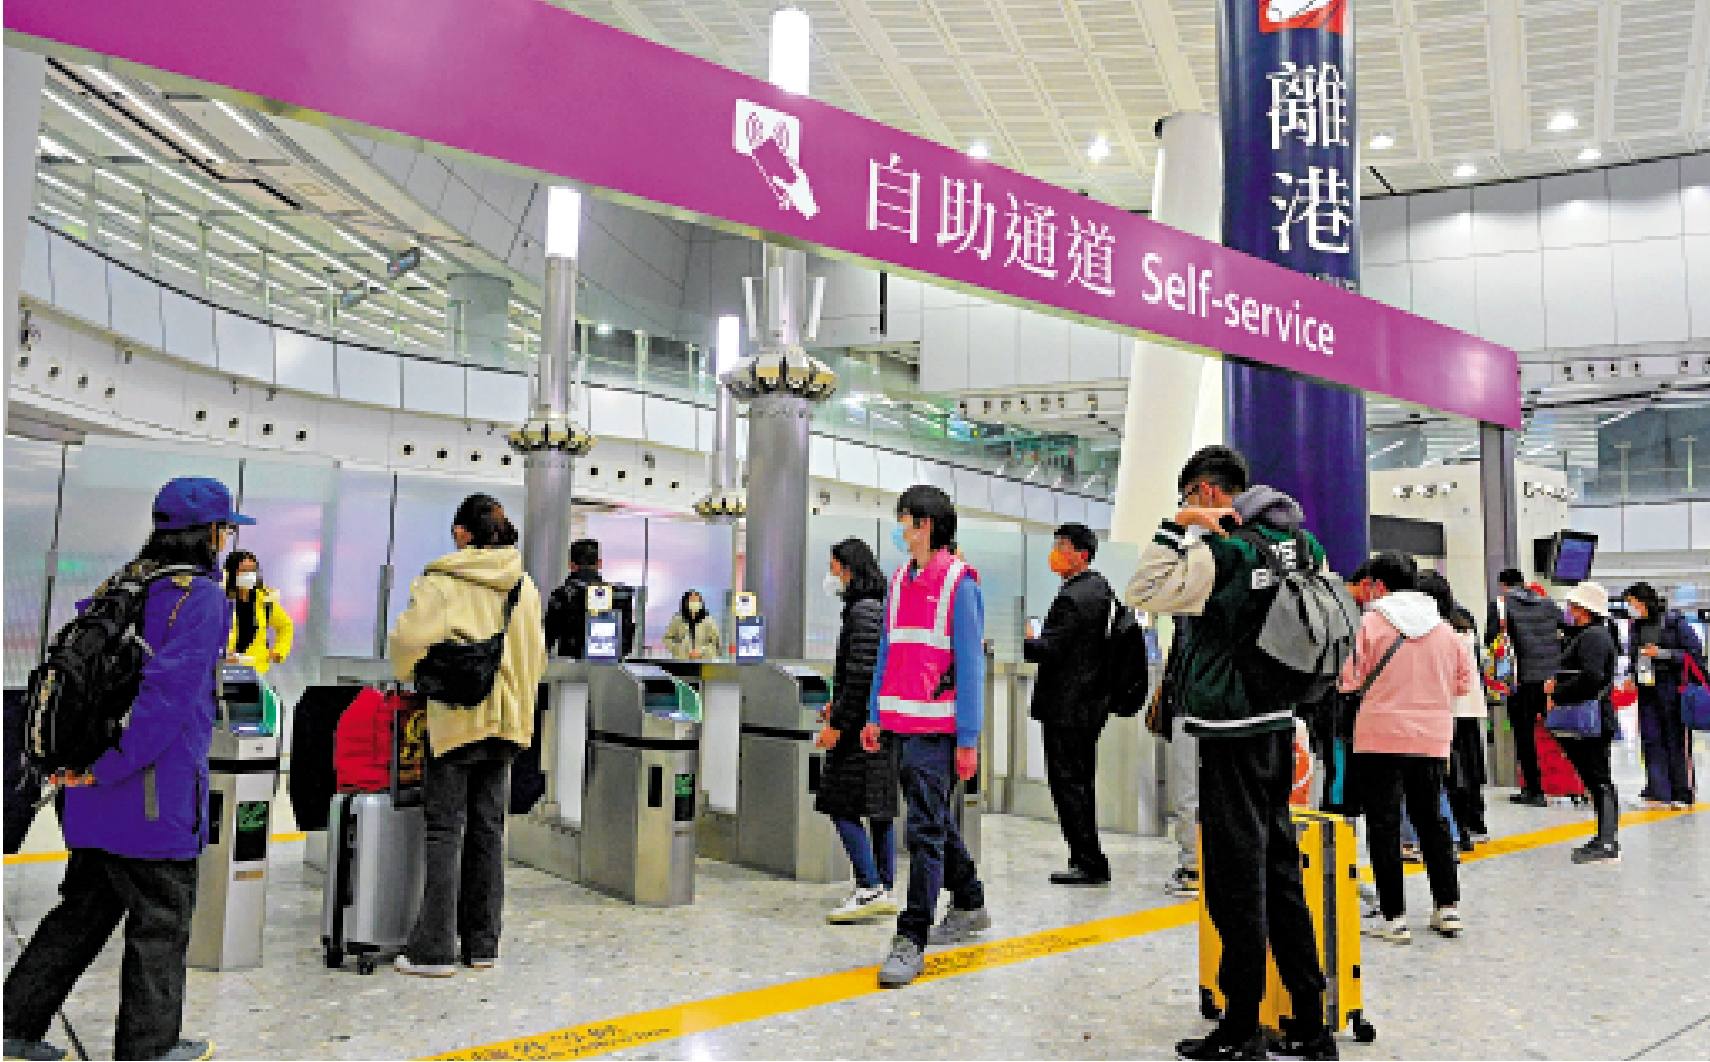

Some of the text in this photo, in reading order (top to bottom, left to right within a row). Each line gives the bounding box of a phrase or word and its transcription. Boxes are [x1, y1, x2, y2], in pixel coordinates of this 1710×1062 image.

[866, 153, 1116, 297] 自助通道
[1266, 61, 1350, 253] 離港
[1141, 252, 1335, 357] Self-service
